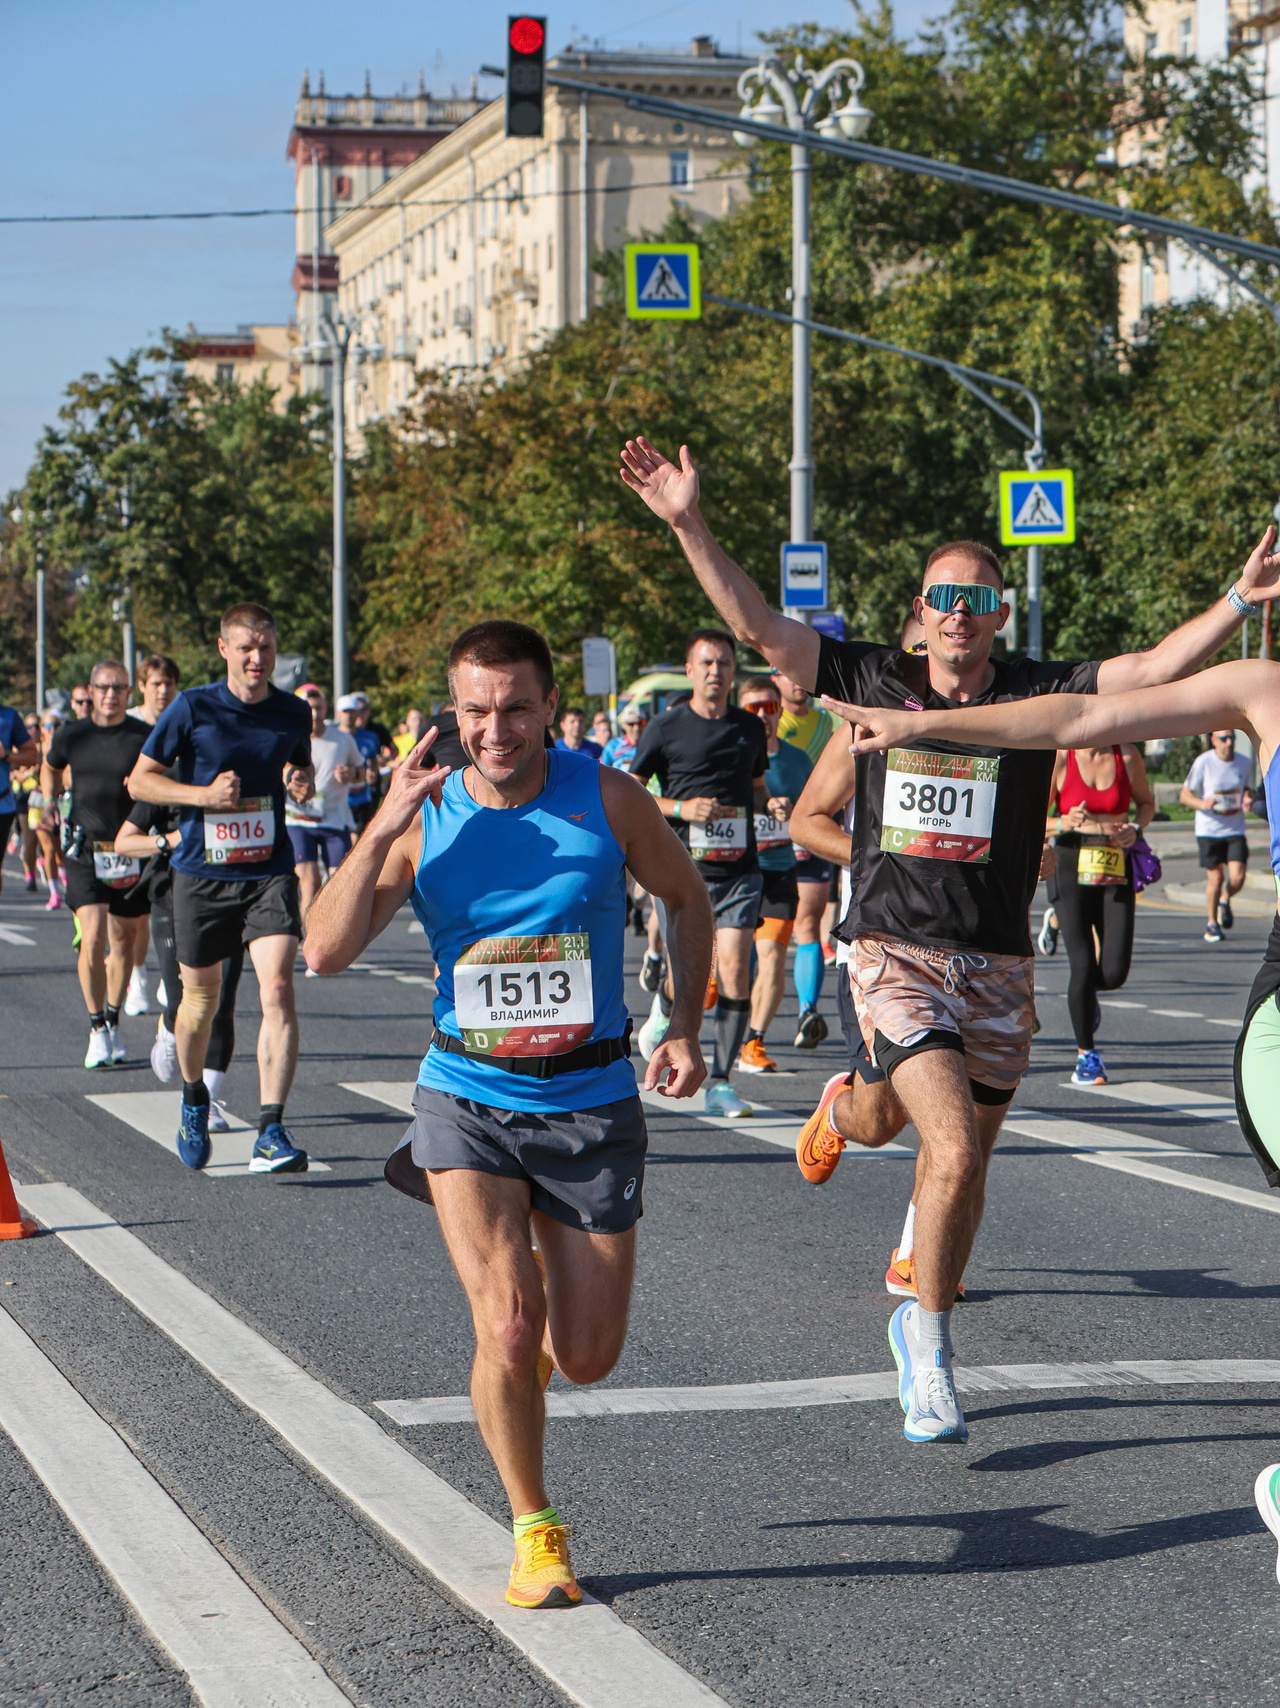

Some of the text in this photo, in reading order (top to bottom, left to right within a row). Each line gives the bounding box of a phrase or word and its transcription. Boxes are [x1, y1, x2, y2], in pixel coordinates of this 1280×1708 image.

[899, 781, 974, 818] 3801
[753, 817, 783, 832] 901
[919, 816, 952, 828] ИГОРЬ
[216, 820, 265, 841] 8016
[705, 823, 735, 838] 846
[215, 849, 224, 860] D
[1090, 850, 1119, 867] 1227
[477, 970, 572, 1008] 1513
[490, 1008, 559, 1022] ВЛАДИМИР
[474, 1032, 489, 1049] D
